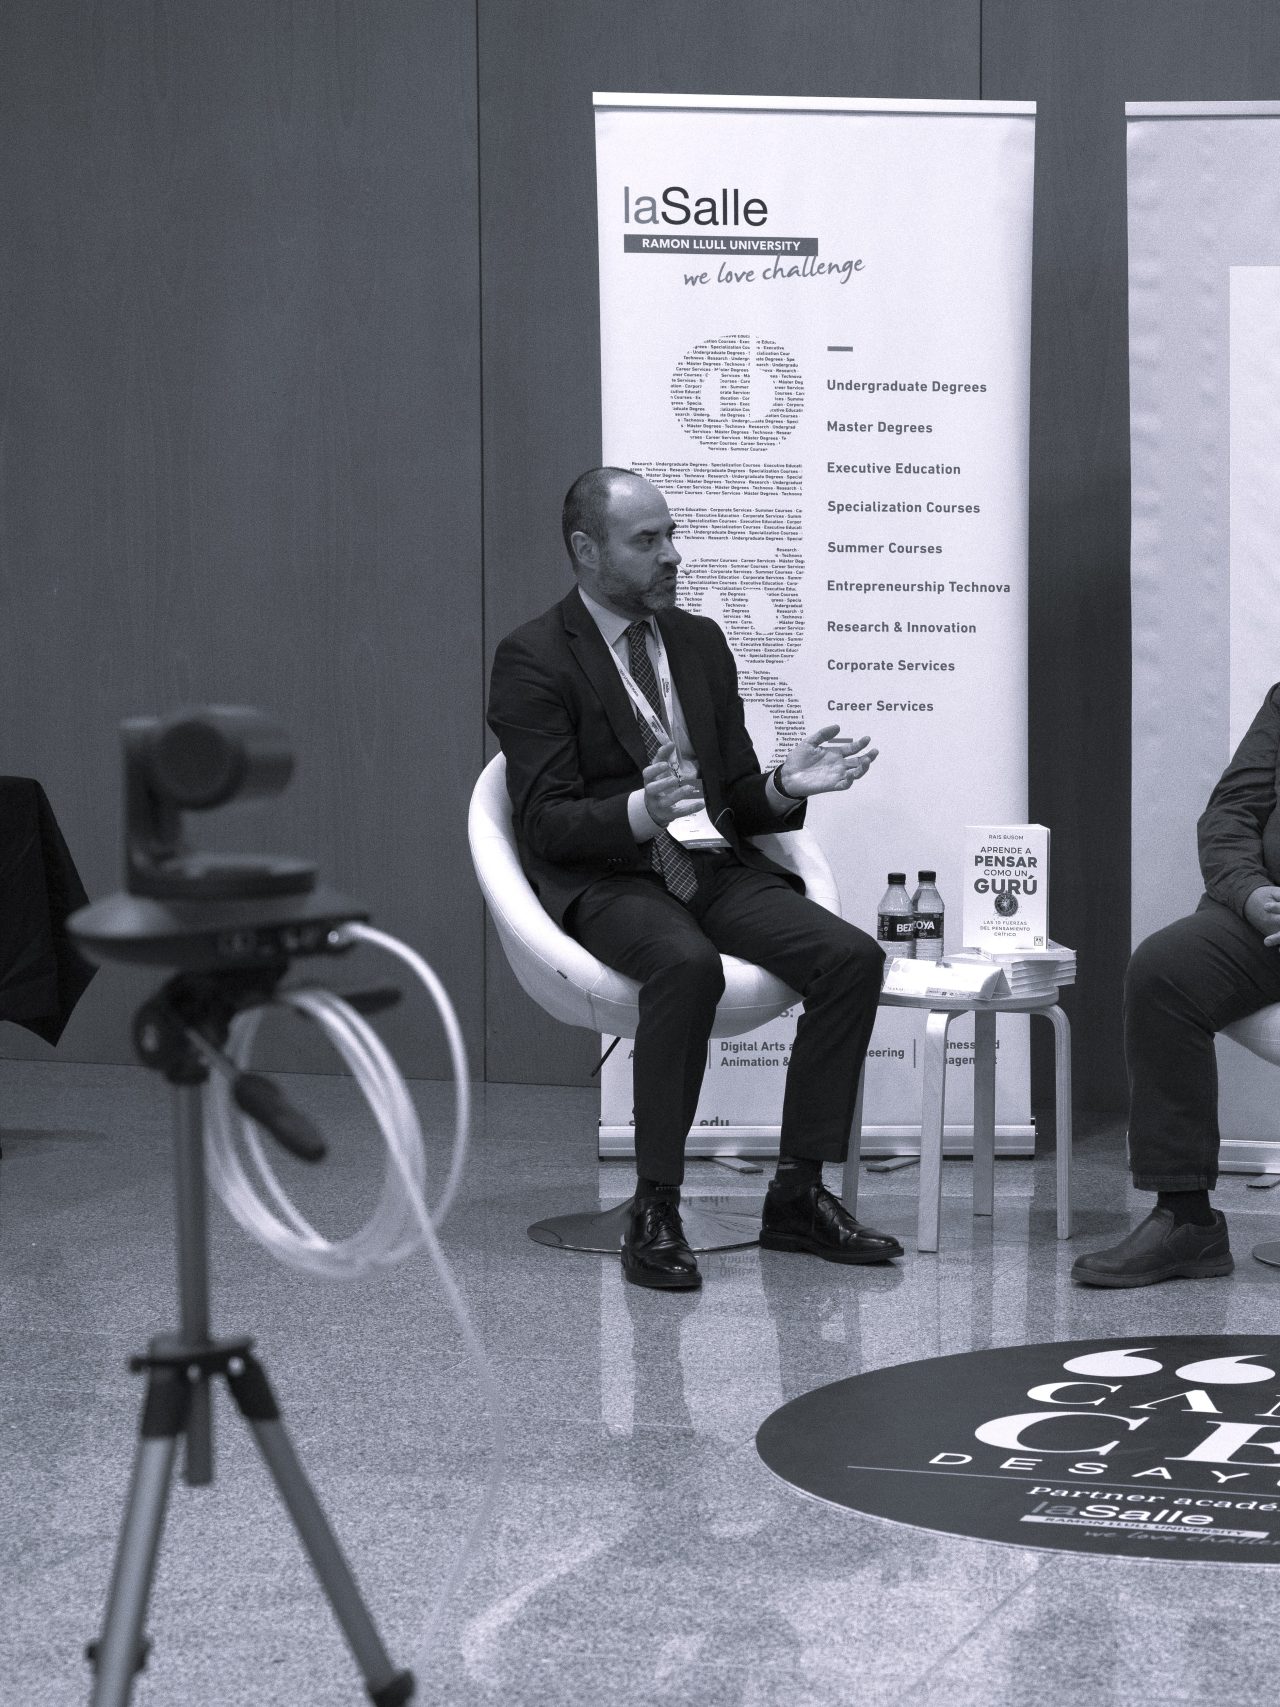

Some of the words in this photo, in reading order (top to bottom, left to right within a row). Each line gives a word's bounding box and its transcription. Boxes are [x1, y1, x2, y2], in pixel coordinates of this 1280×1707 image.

[624, 186, 768, 226] laSalle
[643, 239, 689, 248] RAMON
[694, 240, 726, 249] LLULL
[730, 241, 800, 250] UNIVERSITY
[684, 269, 711, 287] we
[717, 262, 755, 285] love
[763, 255, 865, 285] challenge
[828, 380, 927, 393] Undergraduate
[933, 381, 986, 394] Degrees
[828, 421, 873, 432] Master
[878, 422, 932, 435] Degrees
[828, 462, 891, 473] Executive
[896, 463, 960, 474] Education
[828, 501, 921, 514] Specialization
[927, 502, 980, 513] Courses
[828, 542, 884, 553] Summer
[889, 543, 942, 553] Courses
[828, 580, 944, 594] Entrepreneurship
[949, 582, 1010, 592] Technova
[828, 621, 889, 632] Research
[894, 622, 902, 632] &
[908, 622, 976, 633] Innovation
[828, 659, 893, 672] Corporate
[898, 660, 955, 671] Services
[828, 700, 872, 711] Career
[877, 700, 933, 711] Services
[975, 856, 1037, 868] PENSAR
[974, 875, 1037, 895] GURÚ
[721, 1042, 757, 1053] Digital
[761, 1042, 785, 1051] Arts
[721, 1057, 778, 1066] Animation
[1026, 1486, 1165, 1503] Partner
[1031, 1501, 1214, 1525] laSalle
